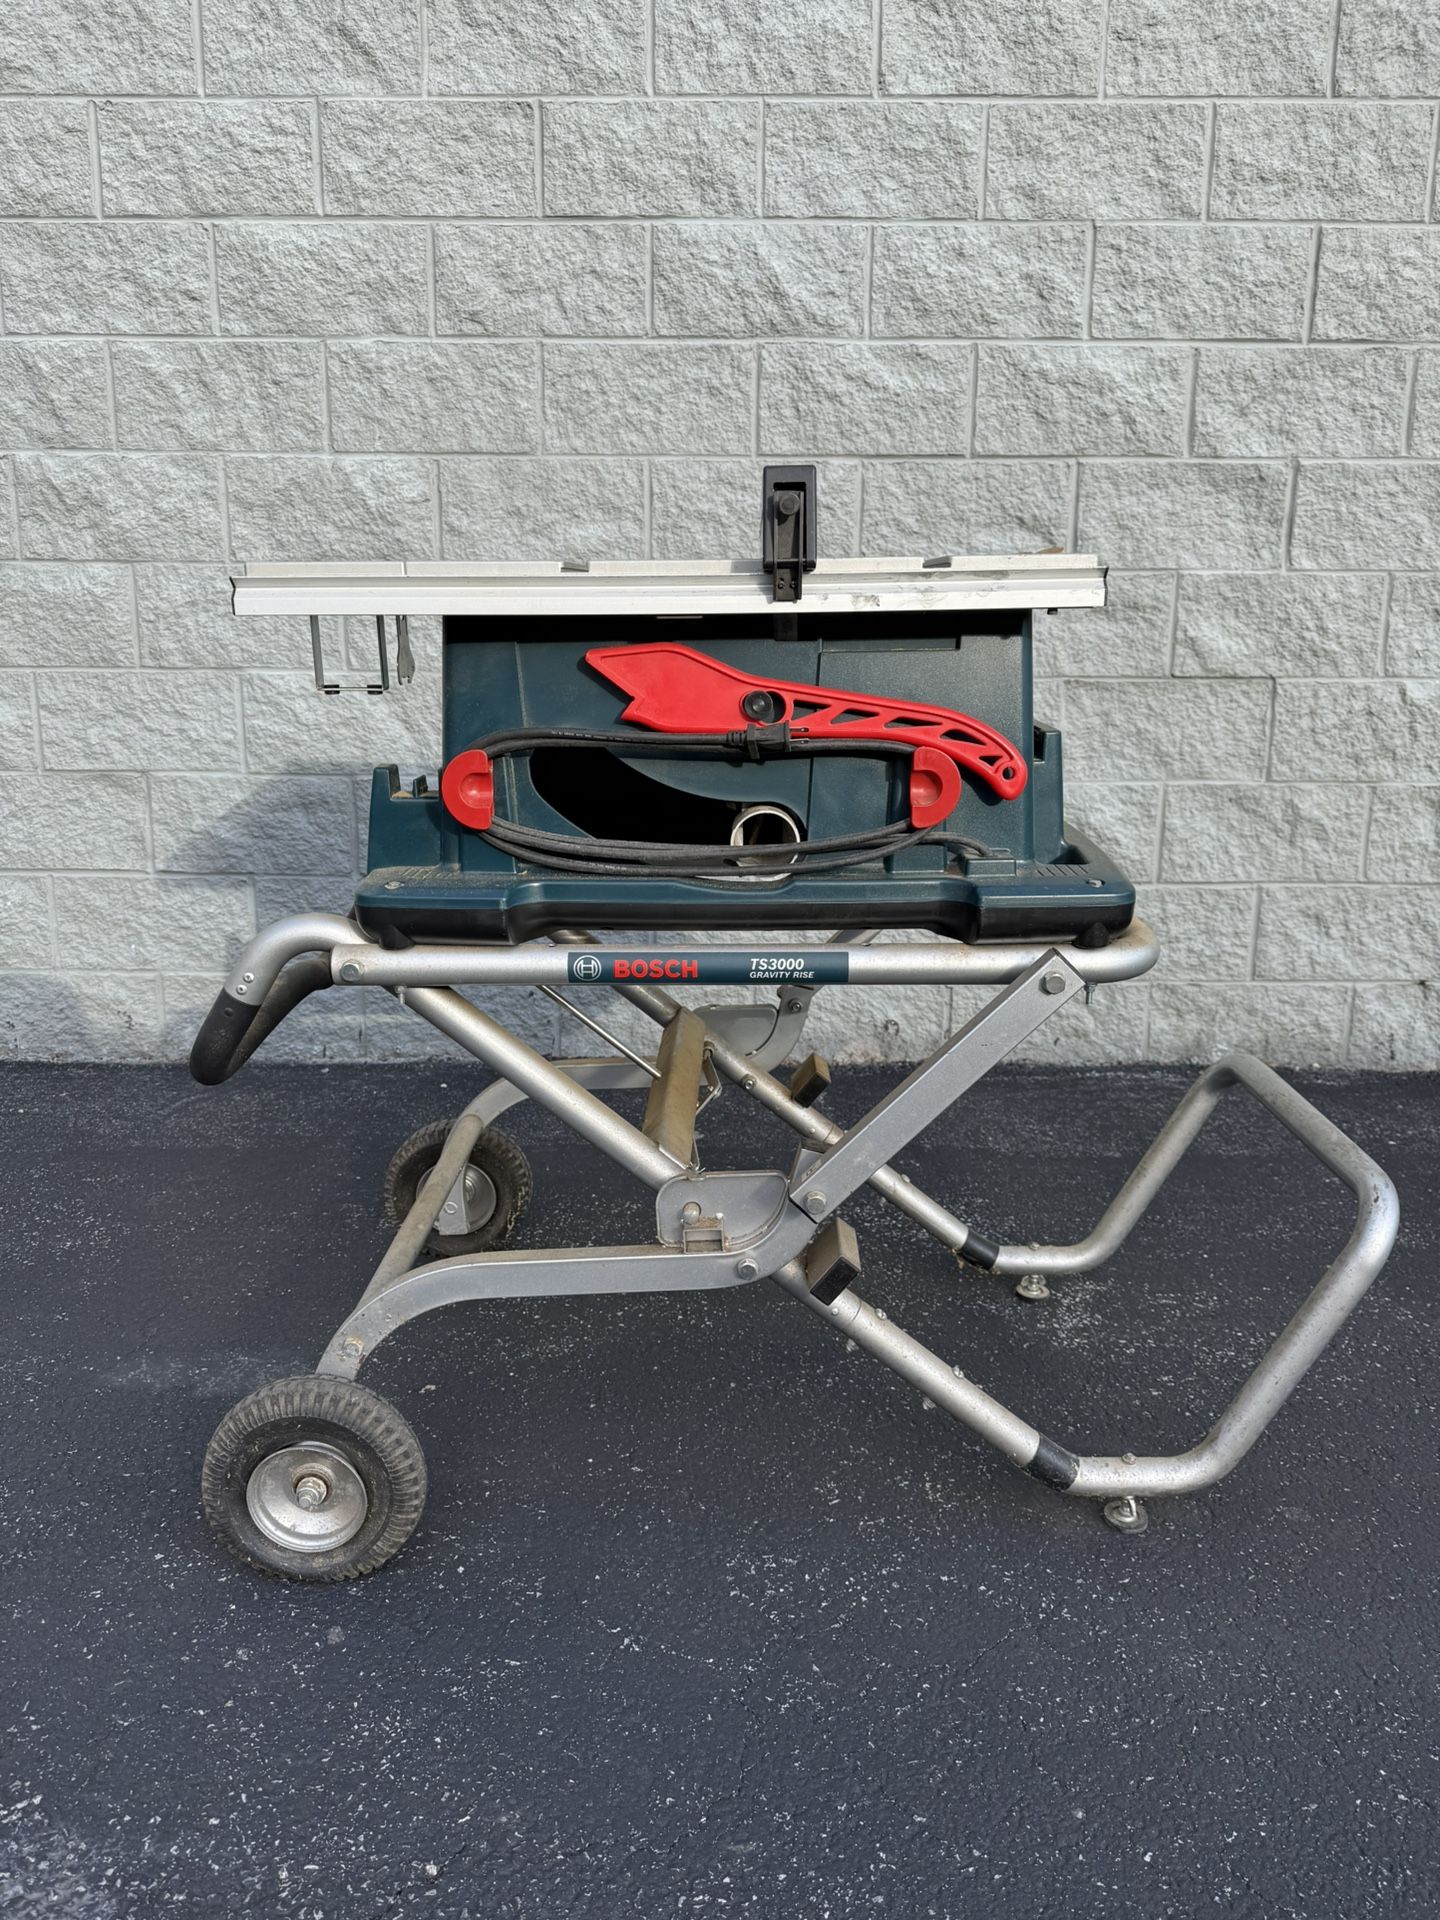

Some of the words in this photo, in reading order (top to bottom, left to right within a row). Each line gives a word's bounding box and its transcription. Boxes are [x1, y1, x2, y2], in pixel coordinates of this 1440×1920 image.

[613, 959, 699, 979] BOSCH
[750, 958, 805, 971] TS3000
[749, 971, 791, 979] GRAVITY
[792, 971, 815, 979] RISE
